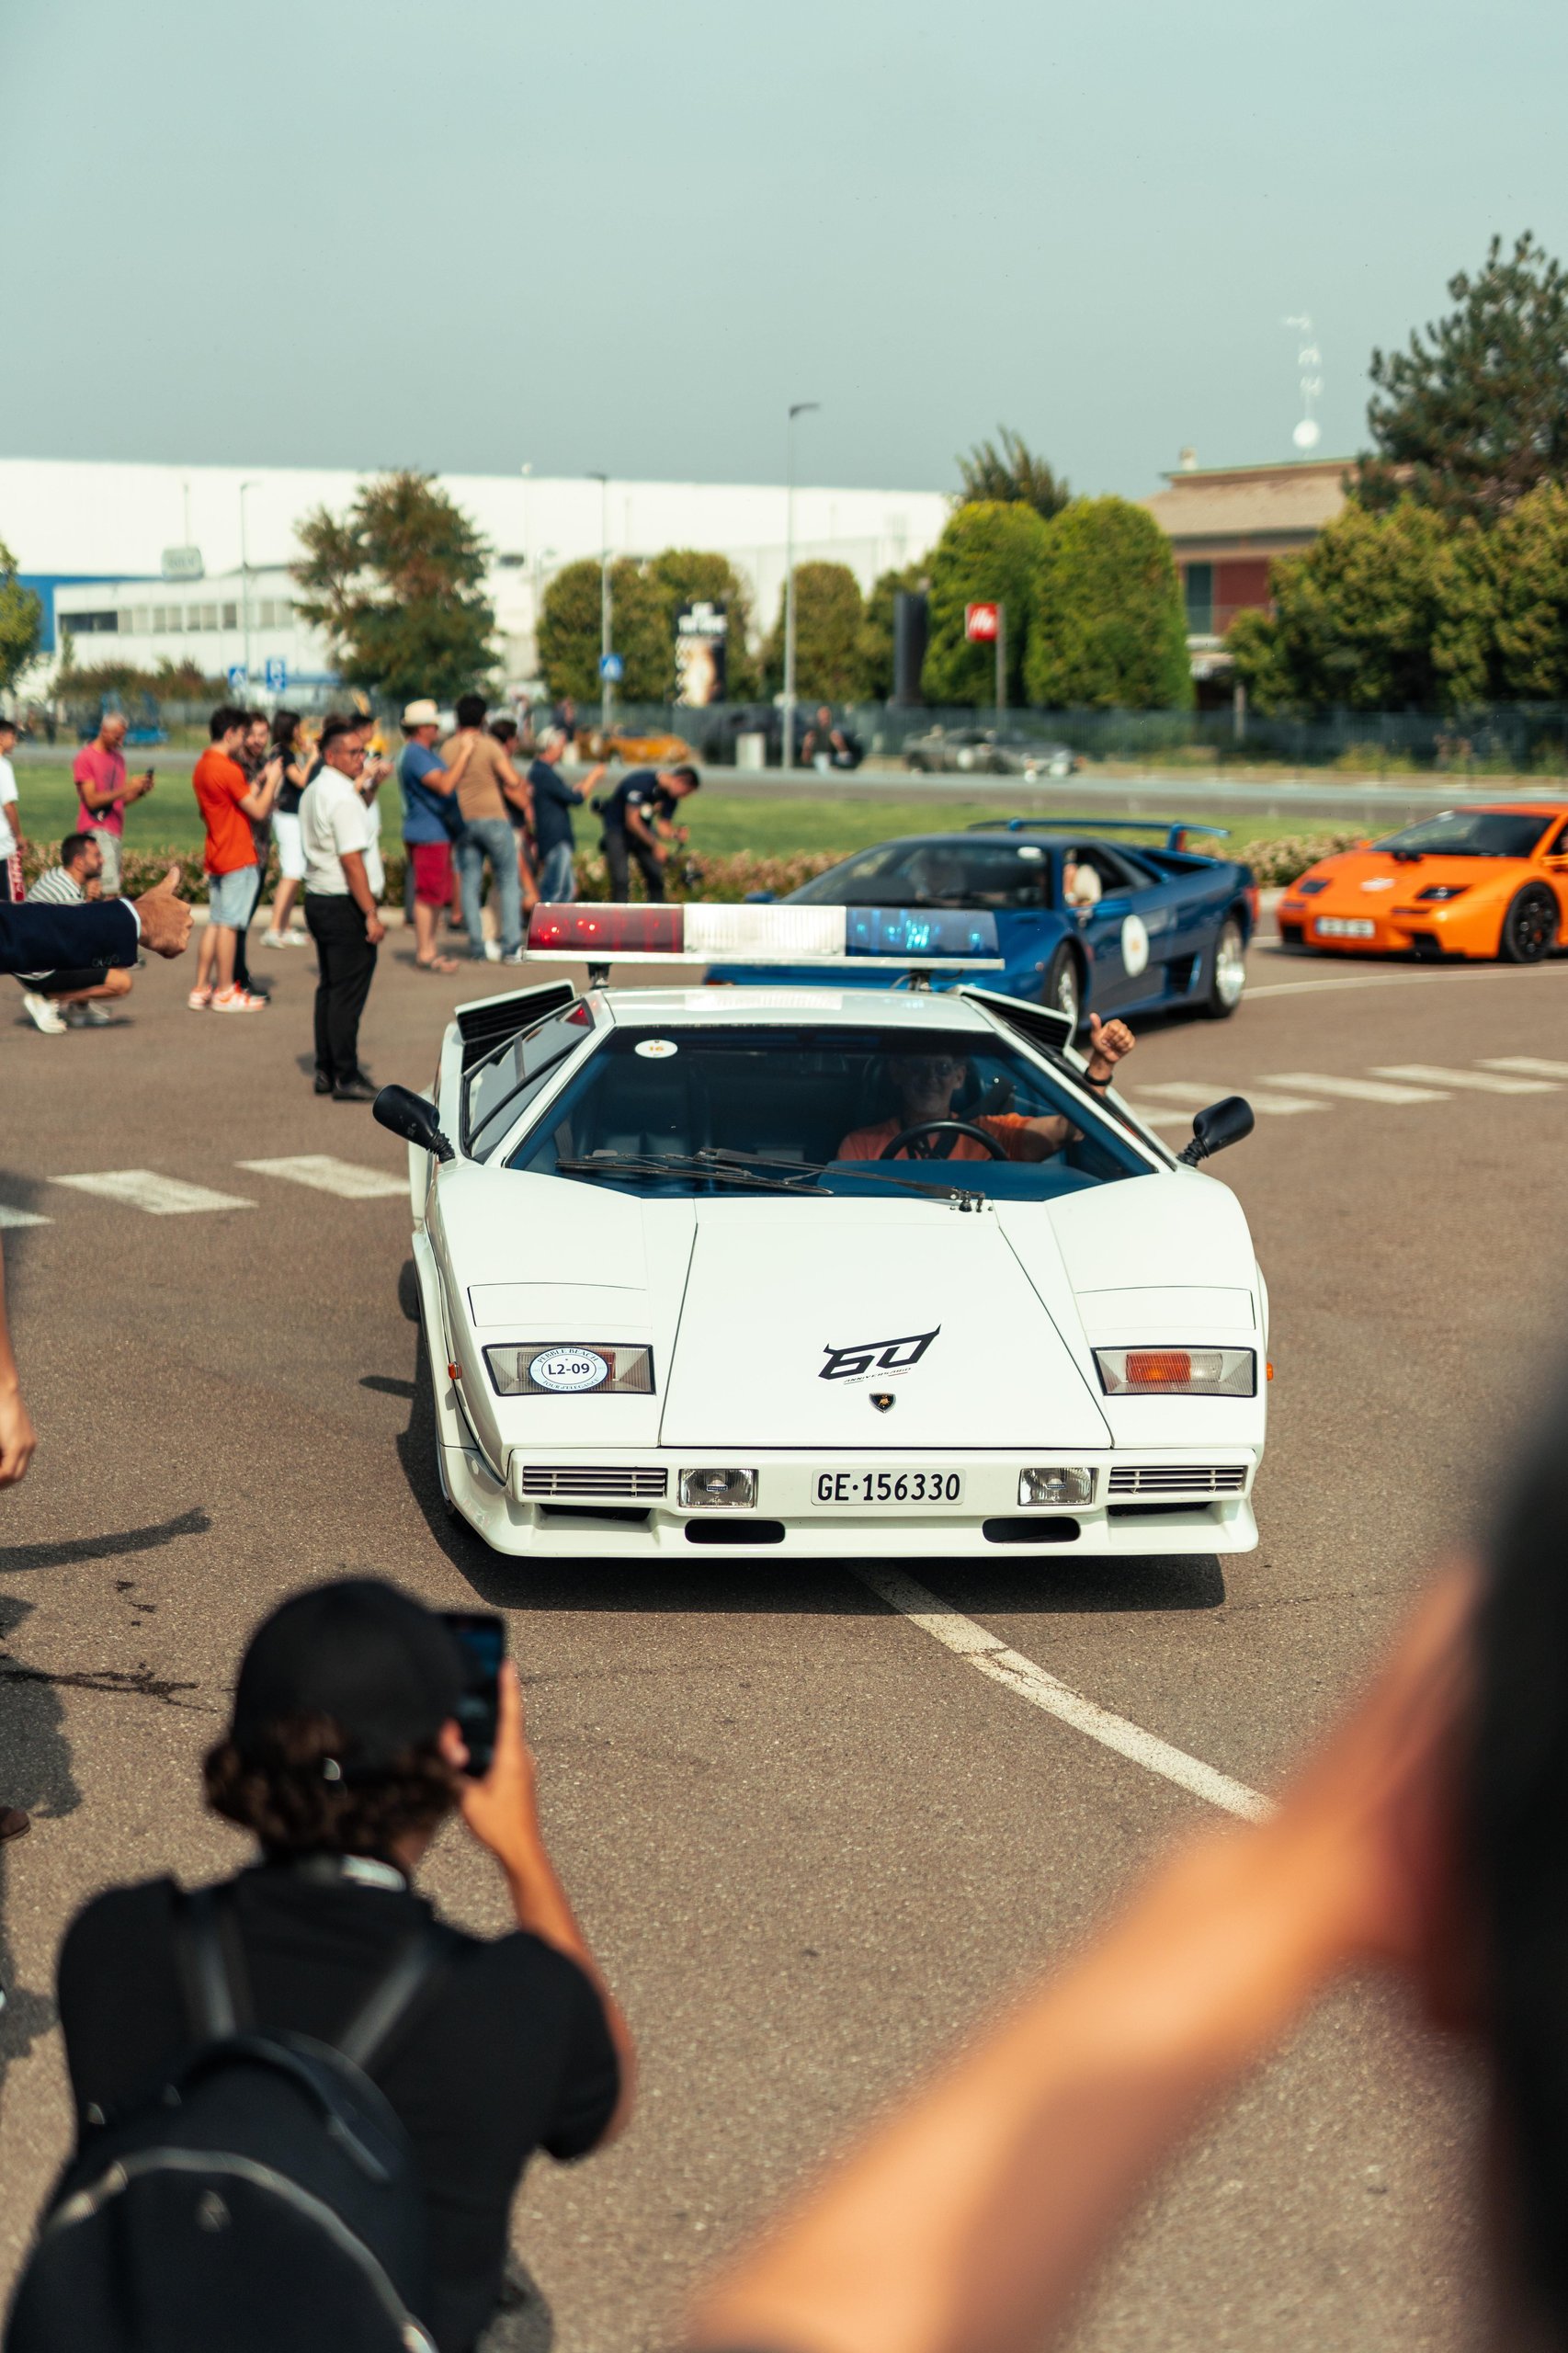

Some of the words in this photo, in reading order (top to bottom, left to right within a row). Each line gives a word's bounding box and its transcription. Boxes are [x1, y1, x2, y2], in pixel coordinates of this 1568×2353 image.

[537, 1348, 567, 1363] PEBBLE
[569, 1348, 599, 1362] BEACH
[818, 1324, 942, 1381] 60
[547, 1363, 590, 1375] L2-09
